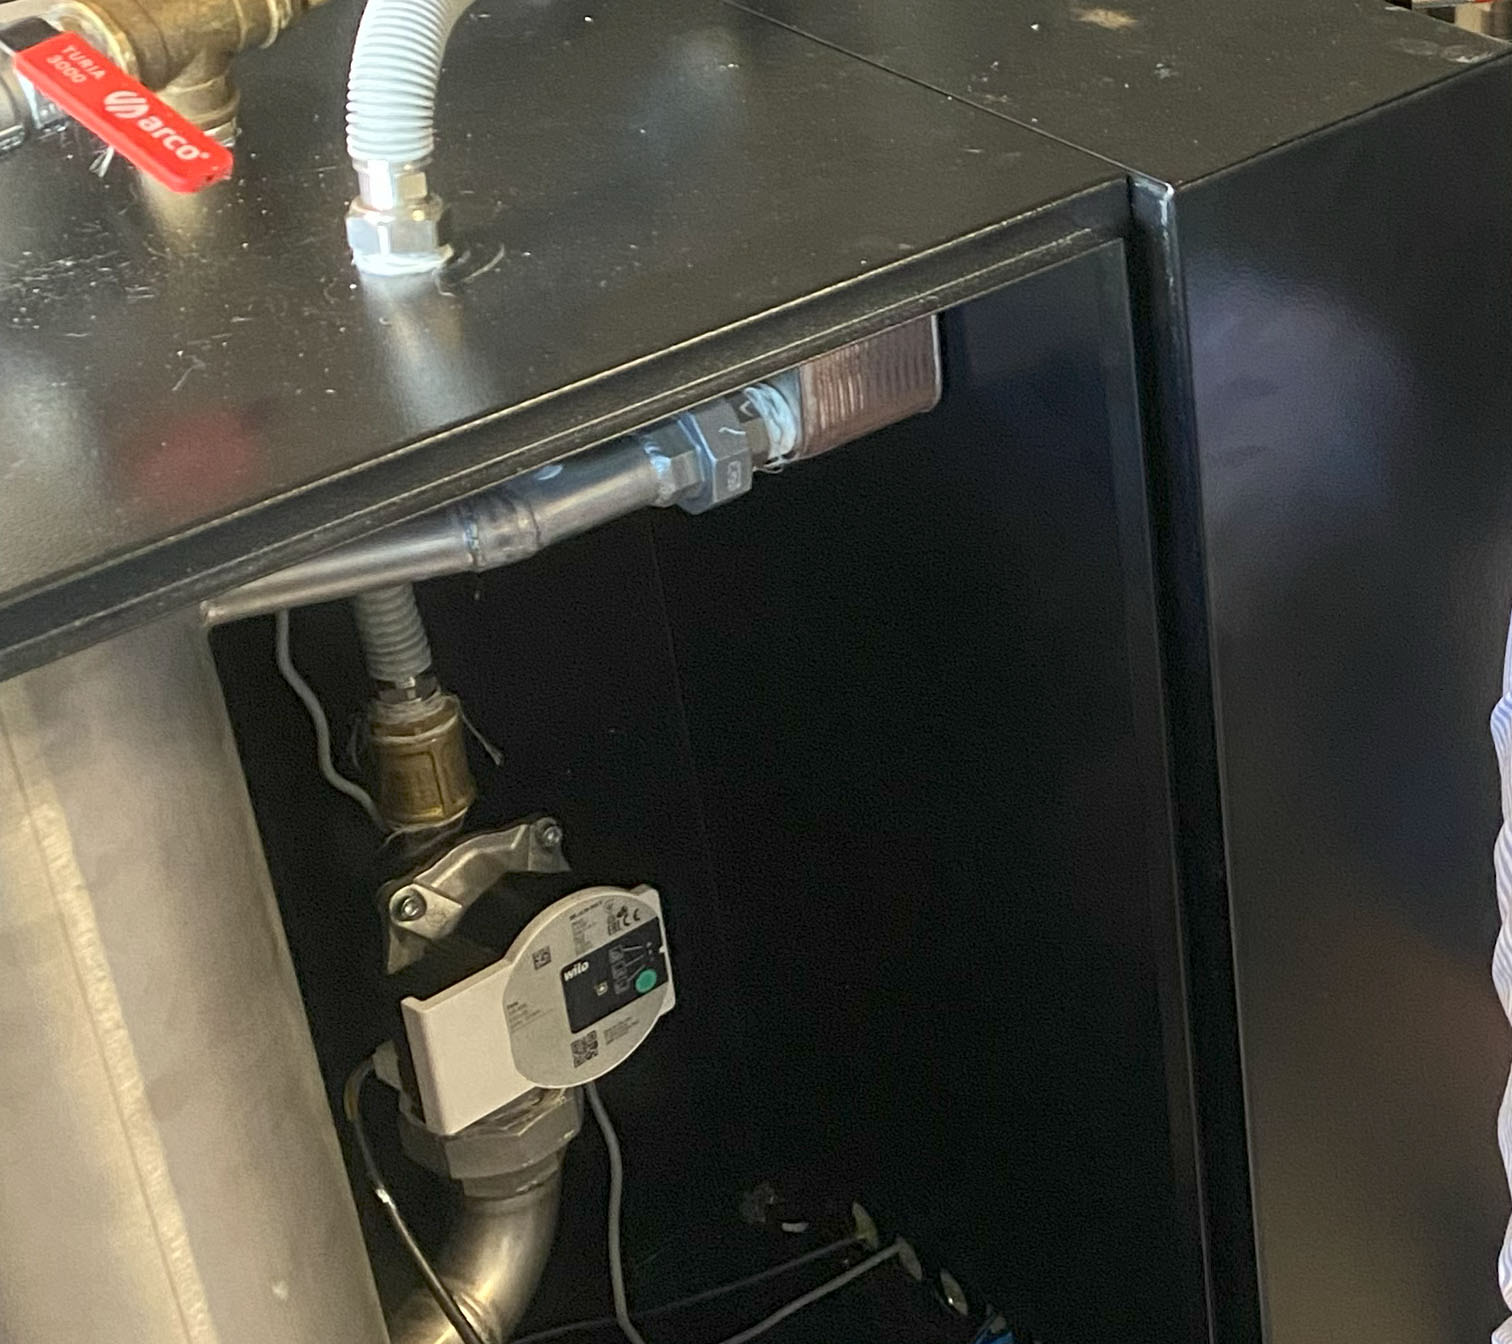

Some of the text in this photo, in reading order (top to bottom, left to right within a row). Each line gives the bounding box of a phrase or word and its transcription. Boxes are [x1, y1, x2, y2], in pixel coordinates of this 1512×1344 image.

[46, 54, 87, 83] 3000
[61, 45, 106, 80] TURIA
[137, 115, 201, 161] arco
[563, 961, 590, 982] wilo
